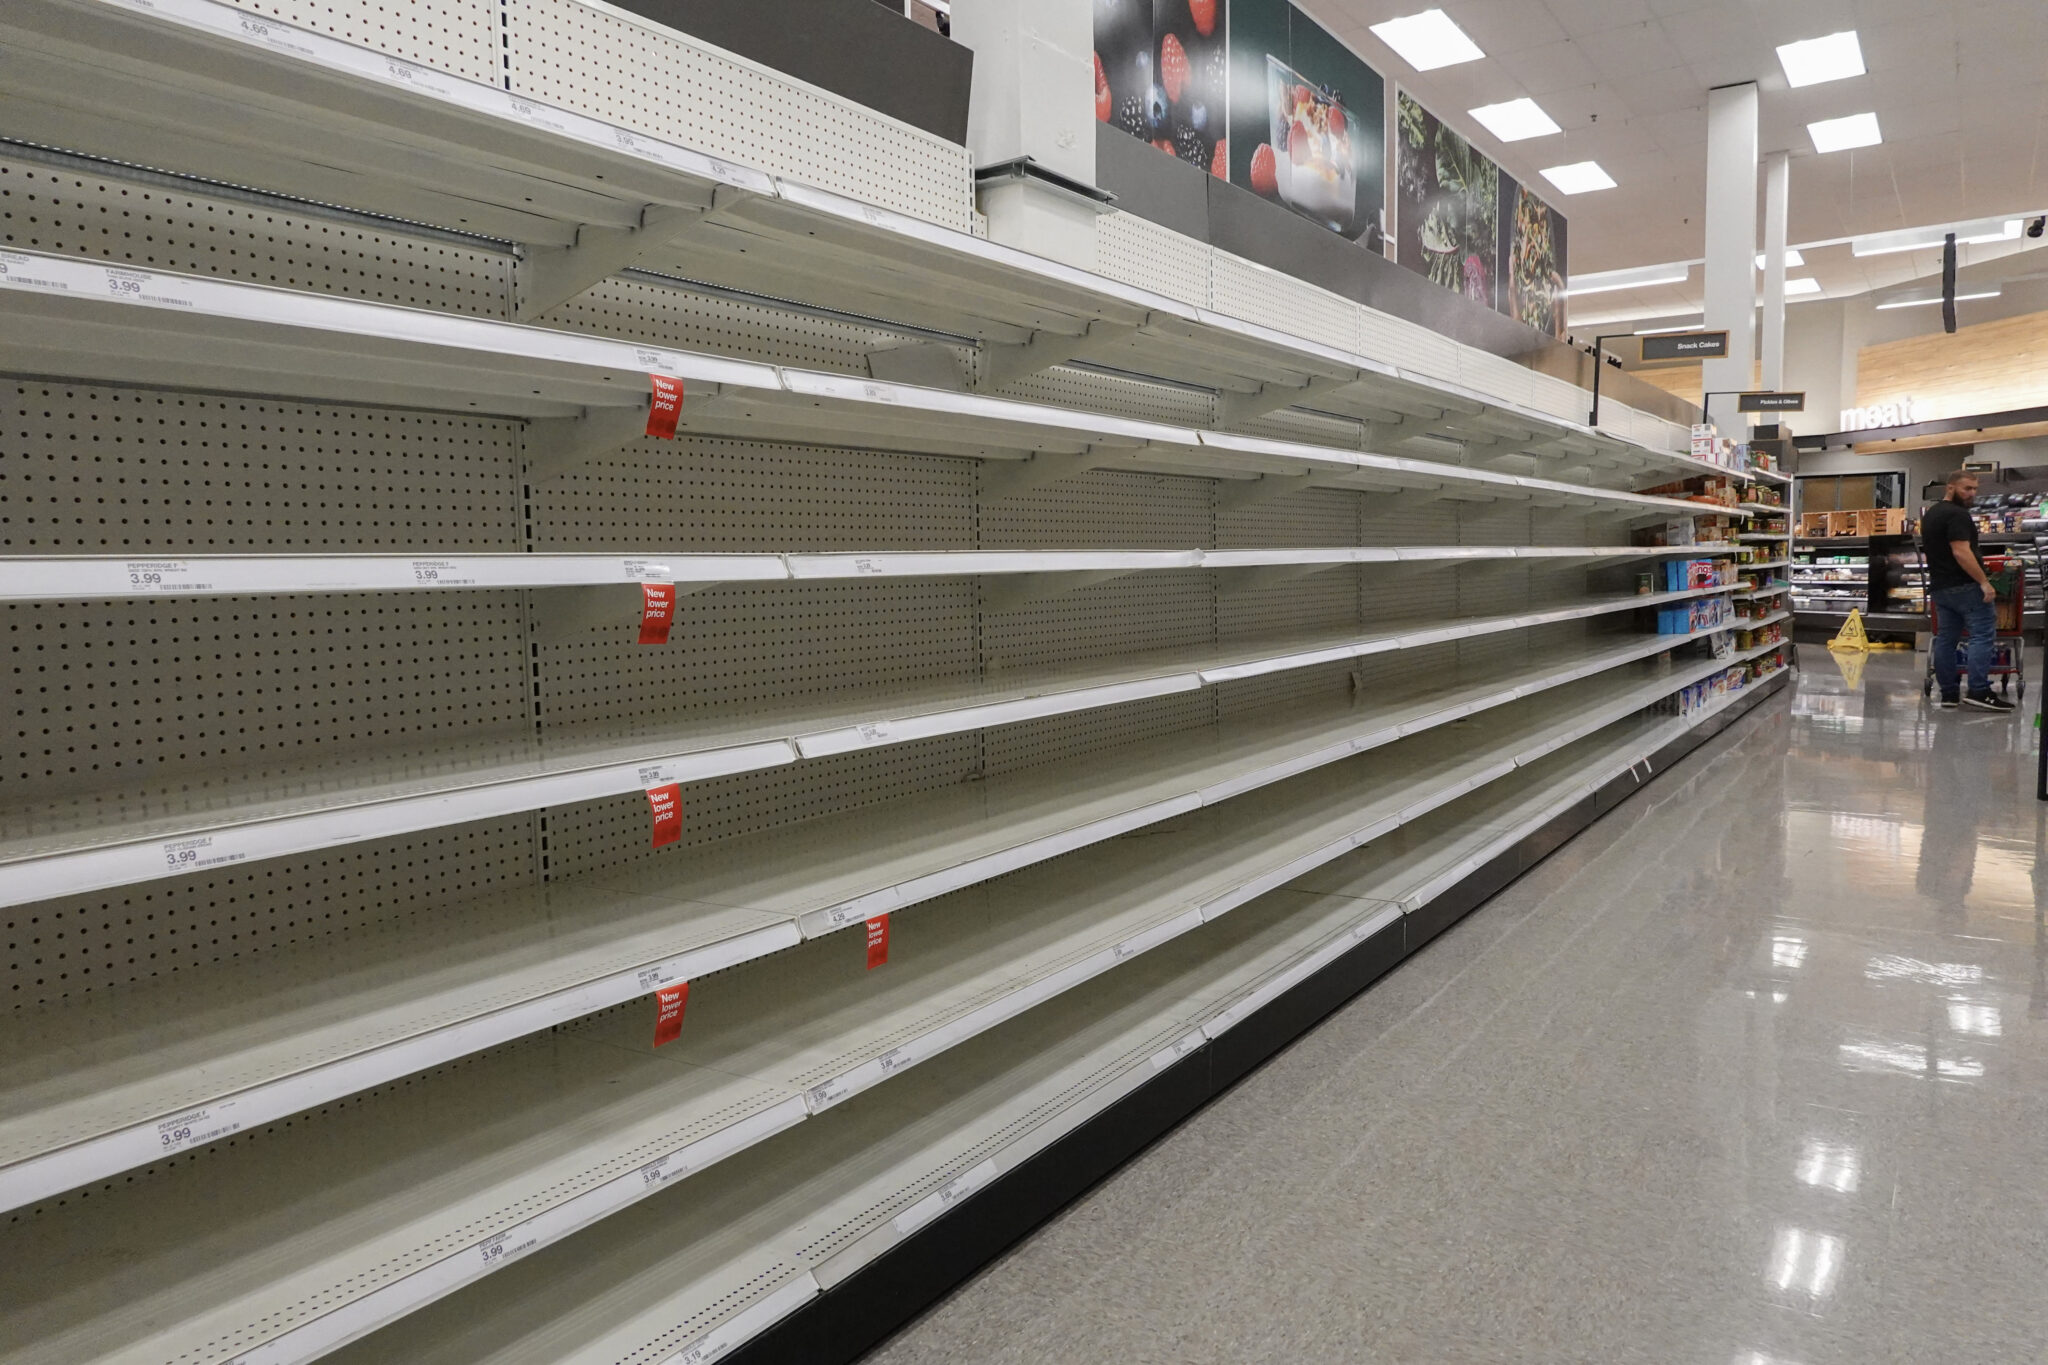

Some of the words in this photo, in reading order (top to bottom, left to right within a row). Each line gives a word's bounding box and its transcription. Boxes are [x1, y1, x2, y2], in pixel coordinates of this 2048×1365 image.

[108, 279, 141, 293] 3.99
[1677, 342, 1698, 350] Snack
[655, 379, 674, 391] New
[656, 389, 678, 402] lower
[655, 400, 674, 411] price
[130, 573, 161, 584] 3.99
[415, 570, 438, 579] 3.99
[646, 588, 665, 598] New
[647, 599, 668, 608] lower
[646, 609, 665, 619] price
[650, 791, 669, 803] New
[653, 800, 674, 813] lower
[655, 811, 673, 824] price
[166, 850, 197, 864] 3.99
[868, 922, 881, 931] New
[868, 929, 884, 939] lower
[868, 937, 882, 948] price
[661, 992, 680, 1003] New
[661, 1000, 682, 1013] lower
[659, 1010, 678, 1023] price
[158, 1112, 201, 1130] PEPPERIDGE
[161, 1127, 191, 1145] 3.99
[643, 1169, 661, 1183] 3.99
[482, 1244, 503, 1261] 3.99
[684, 1350, 701, 1364] 3.19
